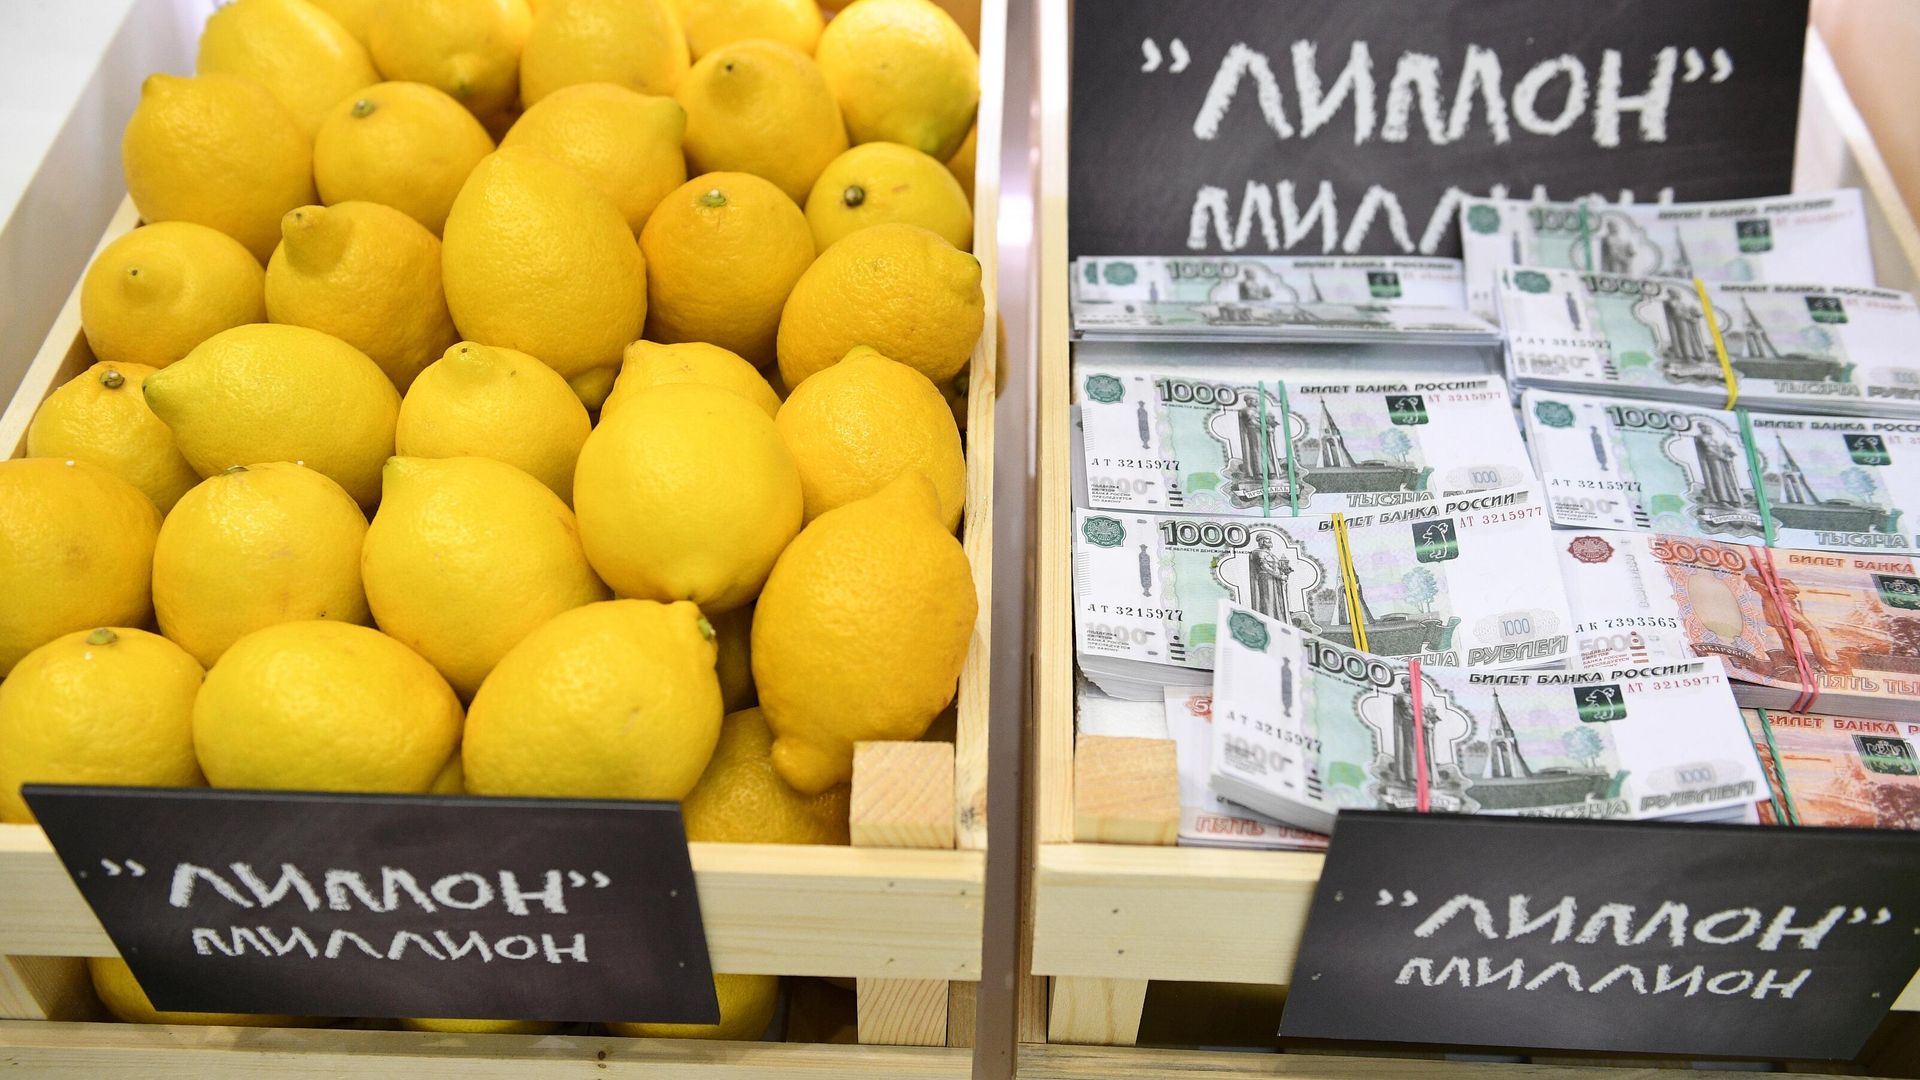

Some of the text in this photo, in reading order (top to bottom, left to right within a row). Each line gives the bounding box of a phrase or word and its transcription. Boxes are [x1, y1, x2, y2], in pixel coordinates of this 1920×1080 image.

[1579, 275, 1661, 297] 1000
[1154, 378, 1239, 406] 1000
[1299, 381, 1478, 394] БИЛЕТ БАНКА РОССИИ
[1605, 404, 1692, 432] 1000
[1117, 459, 1180, 471] 3215977
[1472, 471, 1498, 485] 1000
[1577, 480, 1643, 493] 3215977
[1346, 491, 1435, 508] ТЫСЯЧА
[1378, 505, 1439, 525] БАНКА
[1445, 492, 1515, 515] РОССИИ
[1482, 506, 1542, 525] 3215977
[1159, 520, 1251, 548] 1000
[1814, 532, 1909, 548] ТЫСЯЧА
[1648, 538, 1747, 572] 5000
[1789, 554, 1916, 575] БИЛЕТ БАНКА
[1116, 606, 1183, 621] 3215977
[1605, 616, 1677, 629] 7393565
[1502, 618, 1531, 635] 1000
[1467, 634, 1569, 667] РУБЛЕЙ
[1303, 638, 1395, 688] 1000
[1468, 663, 1691, 685] БИЛЕТ БАНКА РОССИИ
[1653, 675, 1721, 691] 3215977
[1813, 672, 1880, 693] ПЯТЬ
[1255, 720, 1323, 754] 3215977
[1833, 719, 1899, 734] БАНКА
[191, 926, 588, 963] МИЛЛИОН
[1395, 956, 1811, 999] МИЛЛИОН
